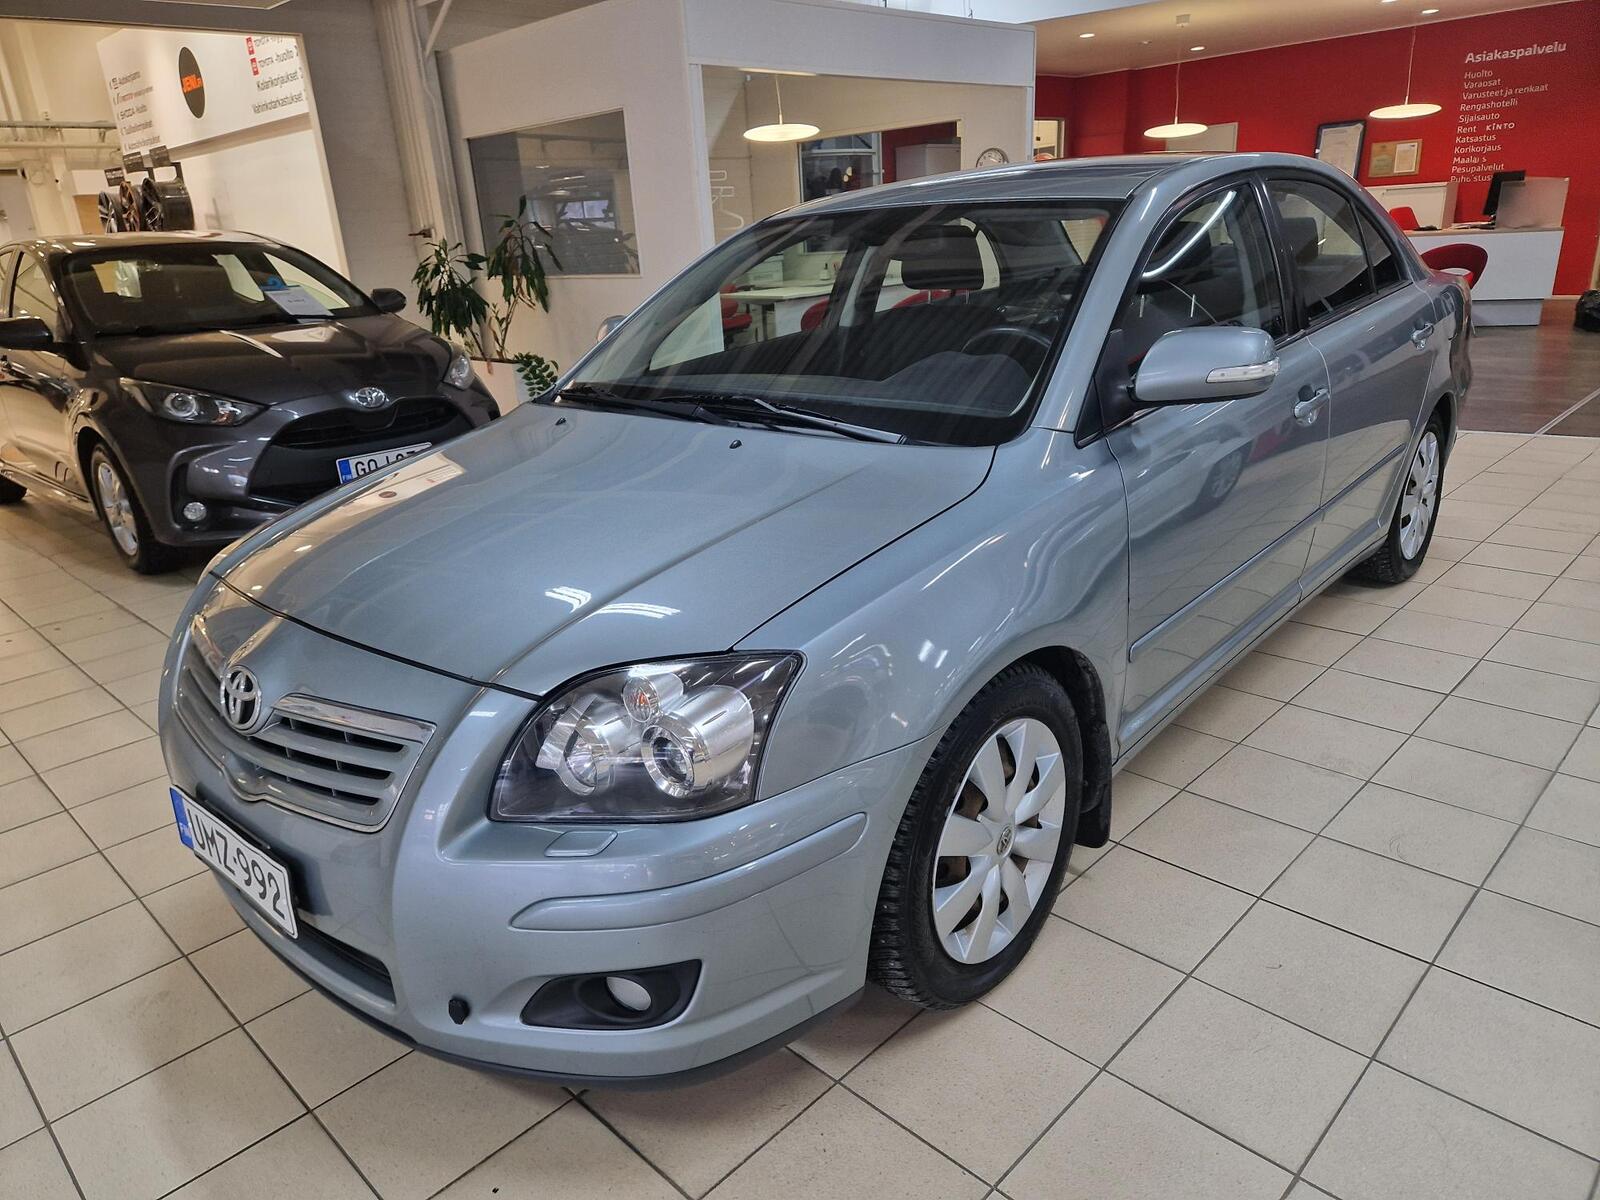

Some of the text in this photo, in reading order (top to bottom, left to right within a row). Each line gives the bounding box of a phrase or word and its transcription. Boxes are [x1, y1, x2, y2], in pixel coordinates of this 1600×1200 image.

[1465, 41, 1567, 64] Asiakaspalvelu
[1464, 69, 1493, 79] Huolto
[1463, 78, 1501, 89] Varaosat
[1462, 84, 1549, 100] Varusteet ja renkaat
[1460, 98, 1518, 112] Rengashotelli
[1459, 112, 1500, 124] Sijaisauto
[1457, 125, 1477, 134] Rent
[1455, 134, 1496, 144] Katsastus
[1454, 144, 1502, 154] Korikorjaus
[1451, 163, 1504, 174] Pesupalvelut
[187, 808, 286, 920] UMZ-992
